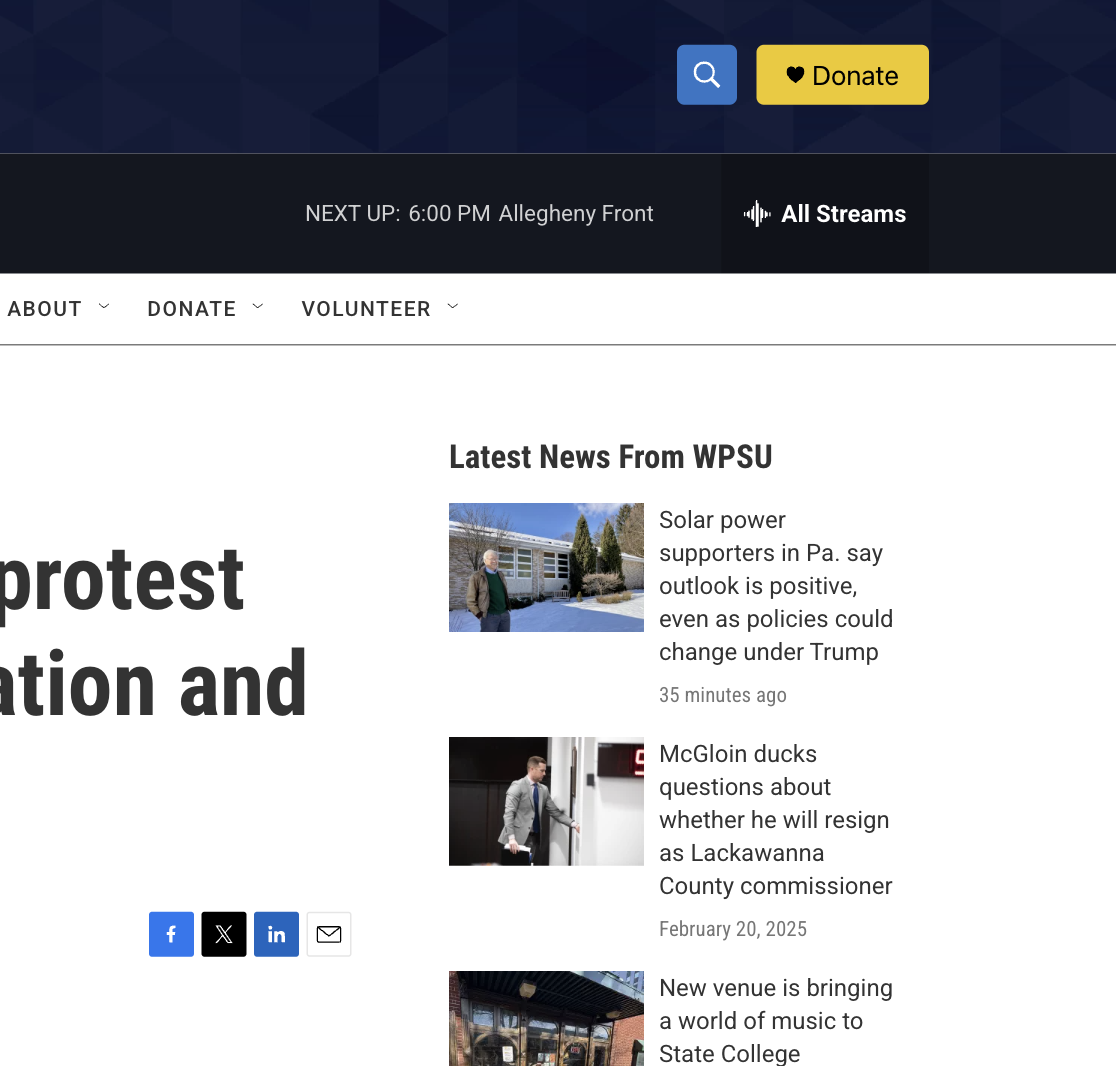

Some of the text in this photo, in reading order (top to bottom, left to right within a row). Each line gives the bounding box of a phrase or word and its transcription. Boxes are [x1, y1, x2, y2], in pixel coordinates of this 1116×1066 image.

[814, 66, 898, 86] Donate
[307, 204, 653, 226] NEXT UP: 6:00 PM Allegheny Front
[781, 204, 906, 223] All Streams
[7, 301, 81, 316] ABOUT
[148, 301, 235, 316] DONATE
[302, 301, 430, 316] VOLUNTEER
[451, 444, 771, 469] Latest News From WPSU
[660, 510, 786, 533] Solar power
[181, 647, 305, 716] and
[660, 1044, 800, 1066] State College
